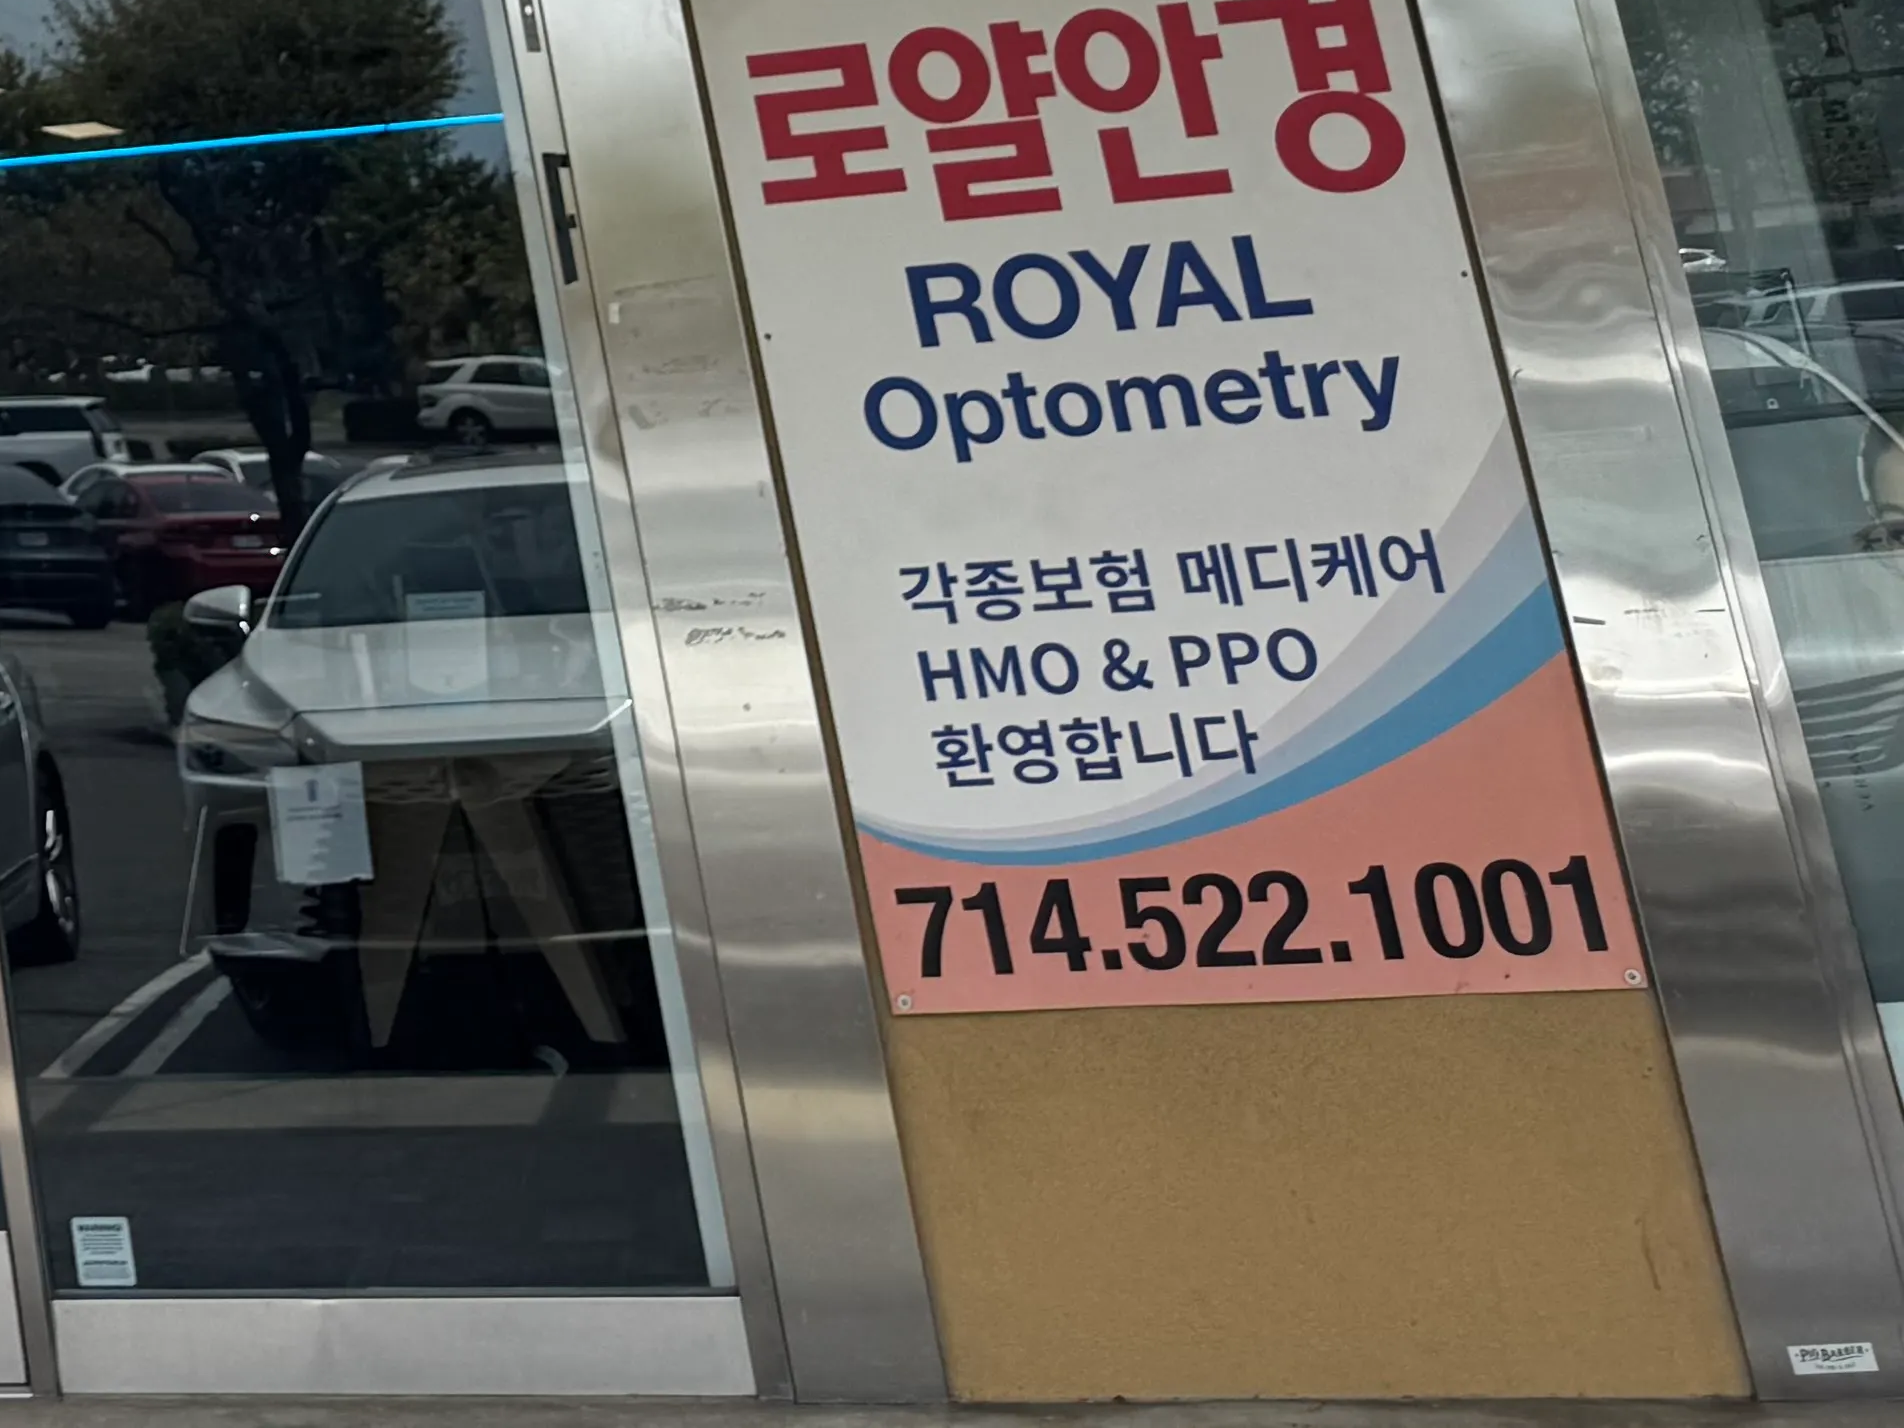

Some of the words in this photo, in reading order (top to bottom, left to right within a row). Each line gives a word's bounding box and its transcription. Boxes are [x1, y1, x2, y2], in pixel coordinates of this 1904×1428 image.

[904, 233, 1314, 350] ROYAL
[862, 350, 1402, 464] Optometry
[898, 555, 1154, 626] 각종보험
[1177, 527, 1448, 605] 메디케어
[916, 640, 1083, 704] HMO
[1101, 638, 1154, 693] &
[1172, 626, 1319, 690] PPO
[931, 708, 1262, 789] 환영합니다
[896, 852, 1609, 982] 714.522.1001
